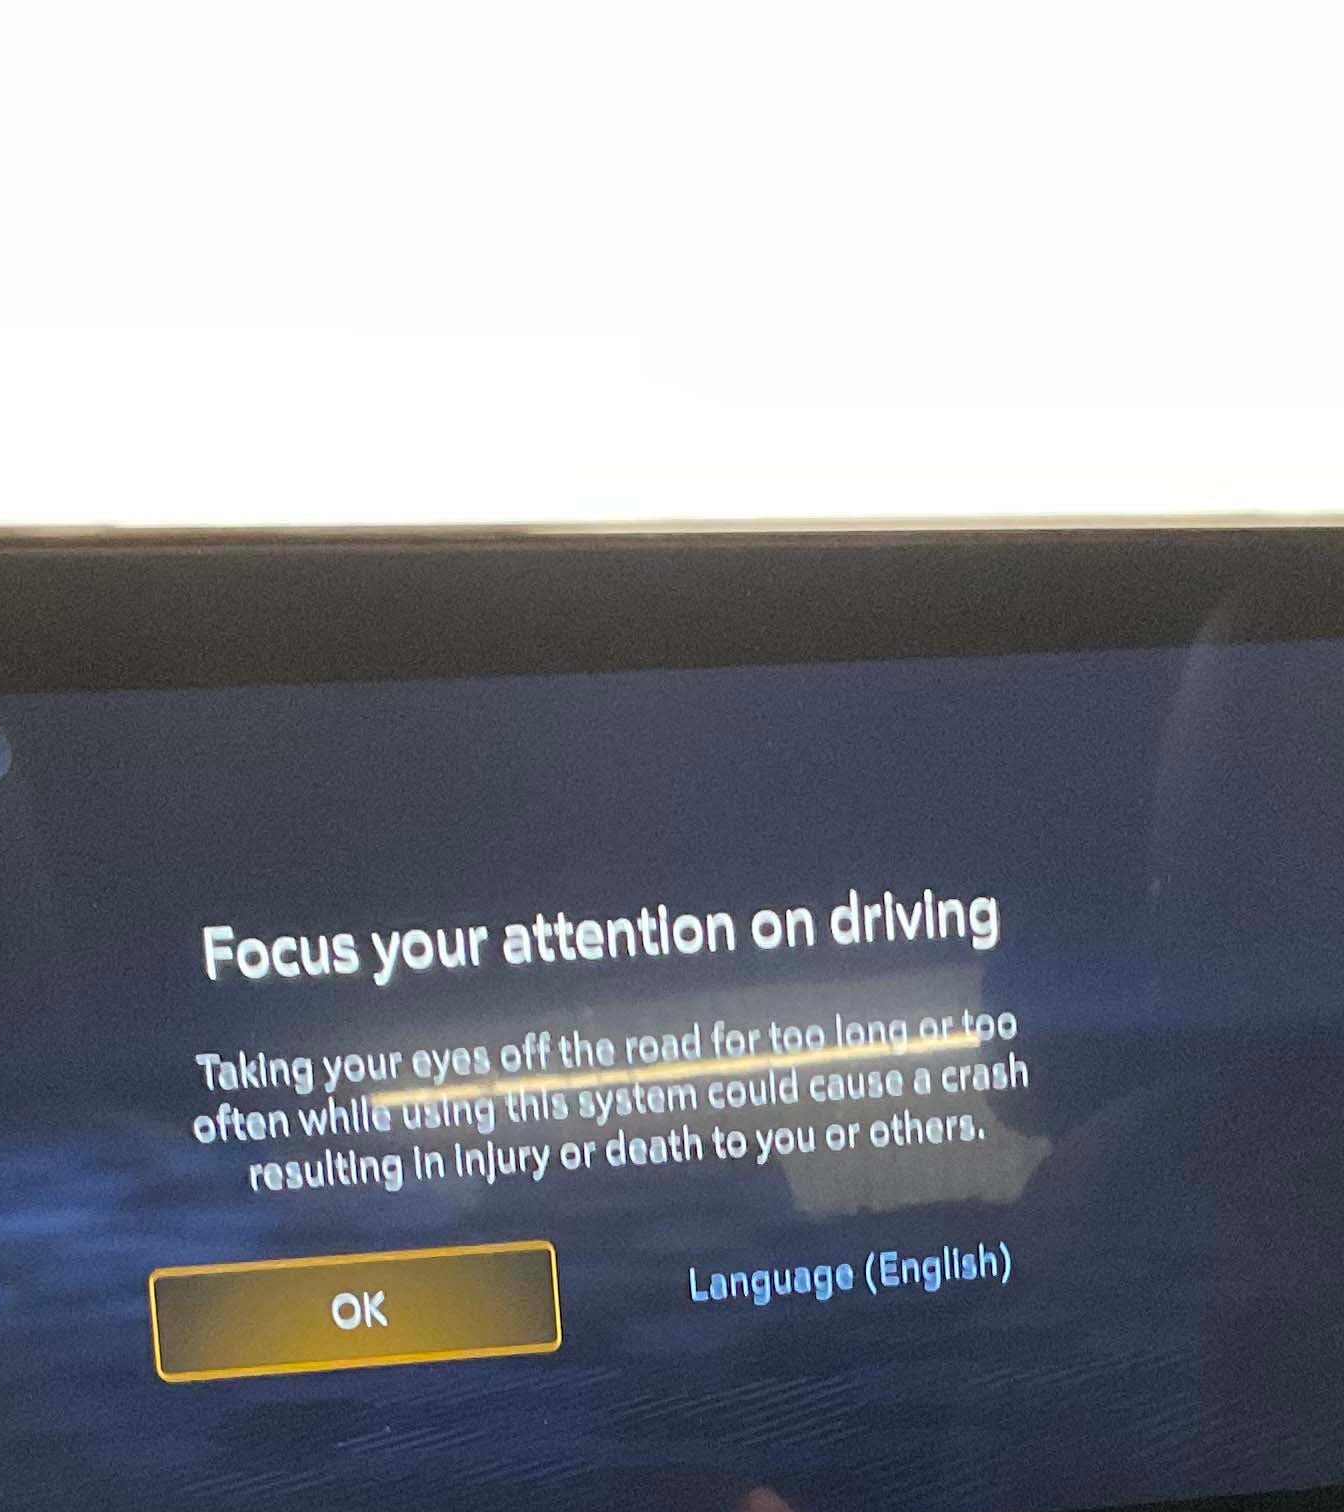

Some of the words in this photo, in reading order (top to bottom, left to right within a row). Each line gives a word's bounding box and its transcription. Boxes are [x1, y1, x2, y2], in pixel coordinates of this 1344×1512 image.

[203, 925, 359, 981] Focus
[372, 926, 488, 986] your
[503, 904, 736, 965] attention
[751, 906, 815, 950] on
[831, 889, 999, 951] driving
[195, 1050, 314, 1095] Taking
[323, 1050, 402, 1093] your
[411, 1046, 491, 1085] eyes
[500, 1031, 551, 1072] off
[559, 1030, 615, 1068] the
[625, 1022, 701, 1063] road
[711, 1020, 761, 1059] for
[769, 1021, 825, 1053] too
[836, 1013, 908, 1056] long
[919, 1016, 953, 1042] or
[962, 1009, 1018, 1041] too
[193, 1102, 290, 1144] often
[299, 1096, 392, 1137] while
[402, 1094, 496, 1134] using
[505, 1087, 569, 1124] this
[578, 1081, 697, 1127] system
[708, 1066, 800, 1109] could
[809, 1068, 904, 1101] cause
[914, 1068, 931, 1095] a
[941, 1051, 1030, 1092] crash
[249, 1149, 404, 1192] resulting
[414, 1145, 445, 1181] in
[455, 1140, 550, 1184] injury
[560, 1140, 596, 1170] or
[605, 1125, 704, 1167] death
[712, 1126, 748, 1159] to
[756, 1126, 815, 1165] you
[826, 1123, 860, 1151] or
[869, 1108, 986, 1149] others.
[330, 1291, 389, 1330] OK
[687, 1260, 854, 1306] Language
[863, 1240, 1013, 1295] (English)
